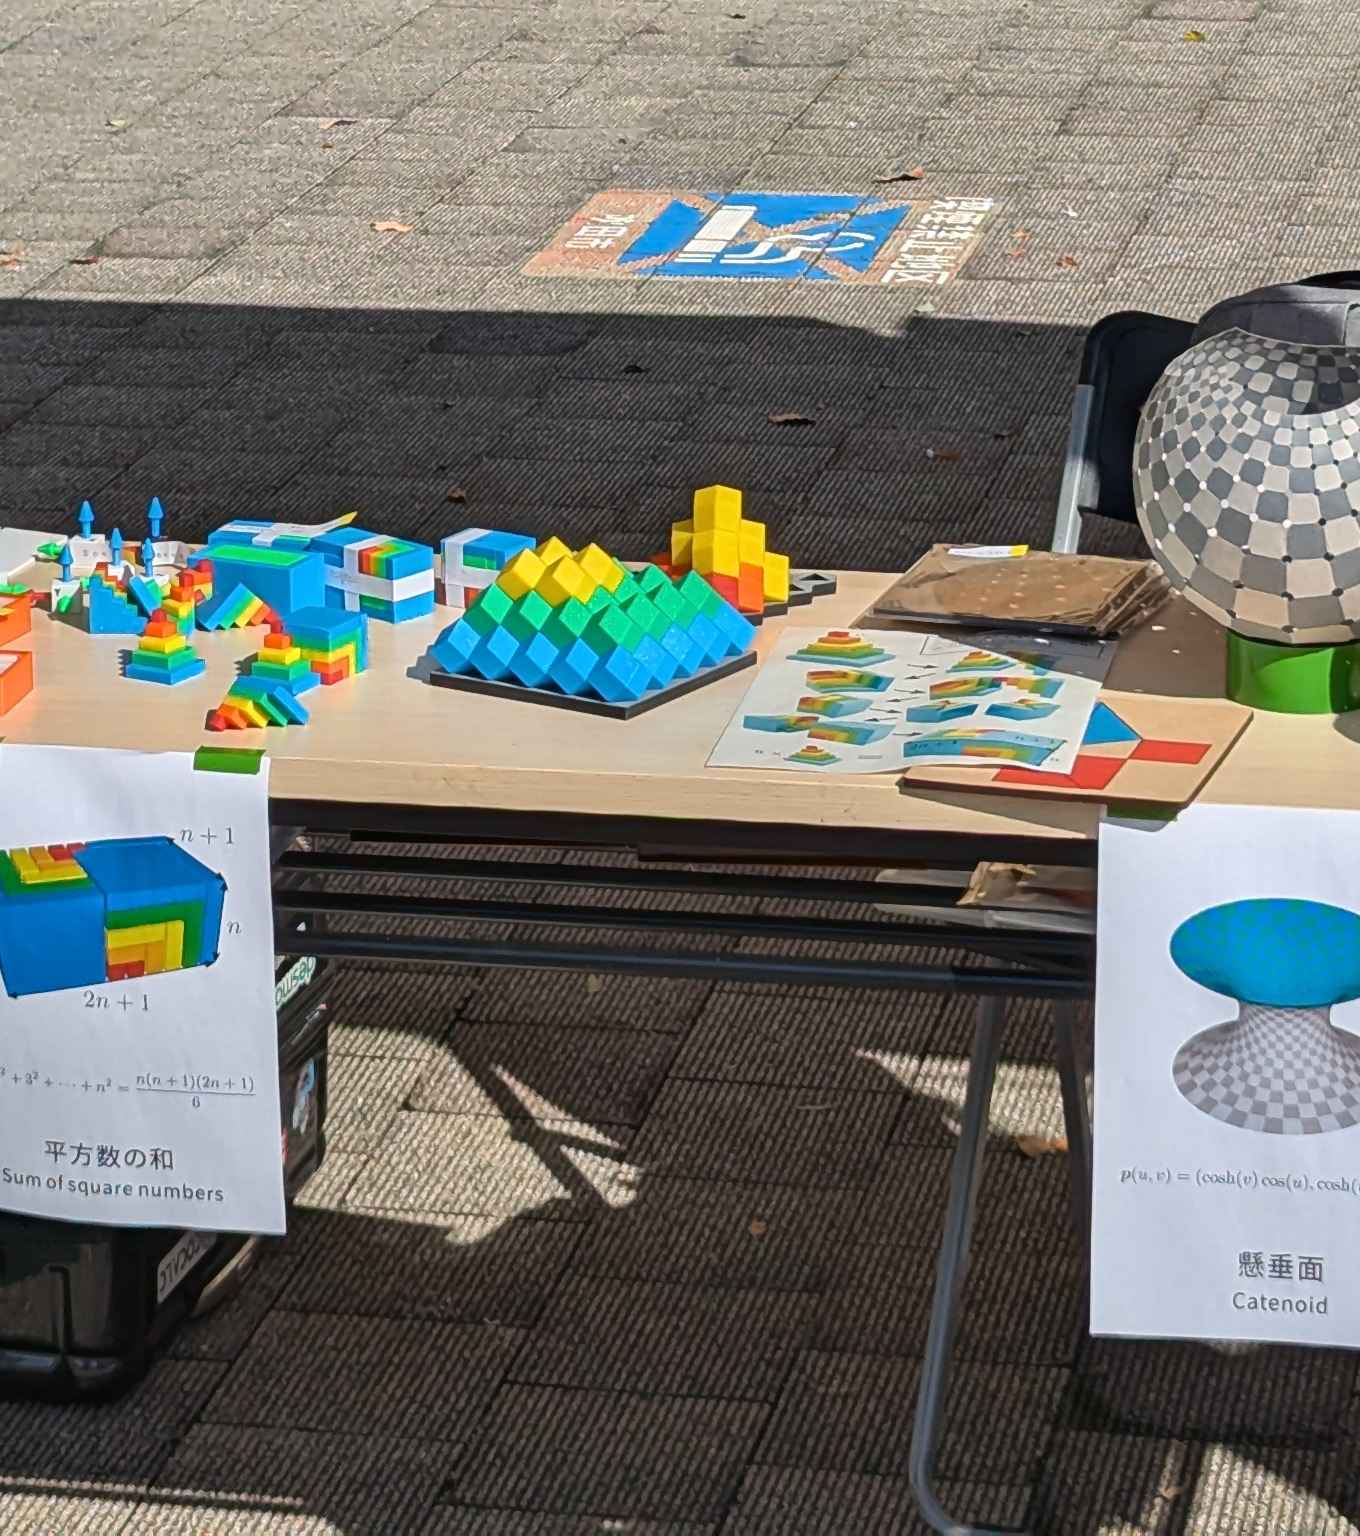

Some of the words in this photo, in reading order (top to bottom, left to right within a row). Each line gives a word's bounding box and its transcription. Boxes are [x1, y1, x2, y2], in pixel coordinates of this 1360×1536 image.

[227, 921, 242, 936] n
[43, 1139, 174, 1171] 平方数の和
[2, 1167, 41, 1187] Sum
[45, 1174, 66, 1190] of
[67, 1178, 133, 1197] square
[137, 1183, 225, 1202] numbers
[1237, 1250, 1325, 1282] 懸垂面
[1231, 1290, 1329, 1315] Catenoid
